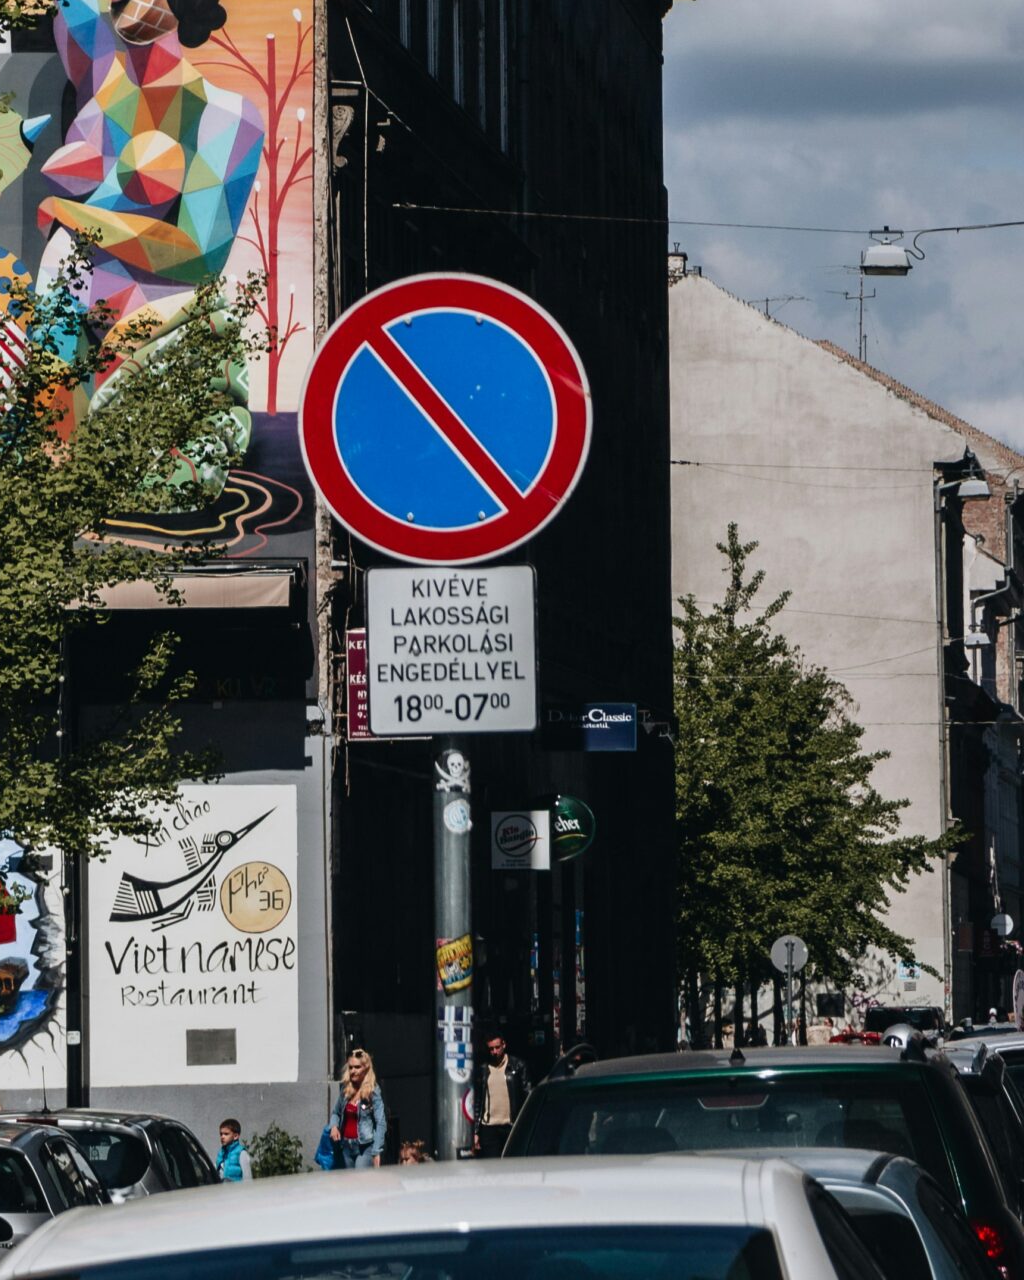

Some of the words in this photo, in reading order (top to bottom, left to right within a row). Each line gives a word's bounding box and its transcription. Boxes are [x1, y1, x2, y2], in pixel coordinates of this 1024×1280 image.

[412, 574, 488, 598] KIVÉVE
[391, 601, 509, 627] LAKOSSÁGI
[394, 629, 514, 655] PARKOLÁSI
[377, 658, 526, 683] ENGEDÉLLYEL
[259, 890, 284, 911] 36
[105, 935, 296, 975] Vietnamese
[121, 980, 265, 1007] Restaurant
